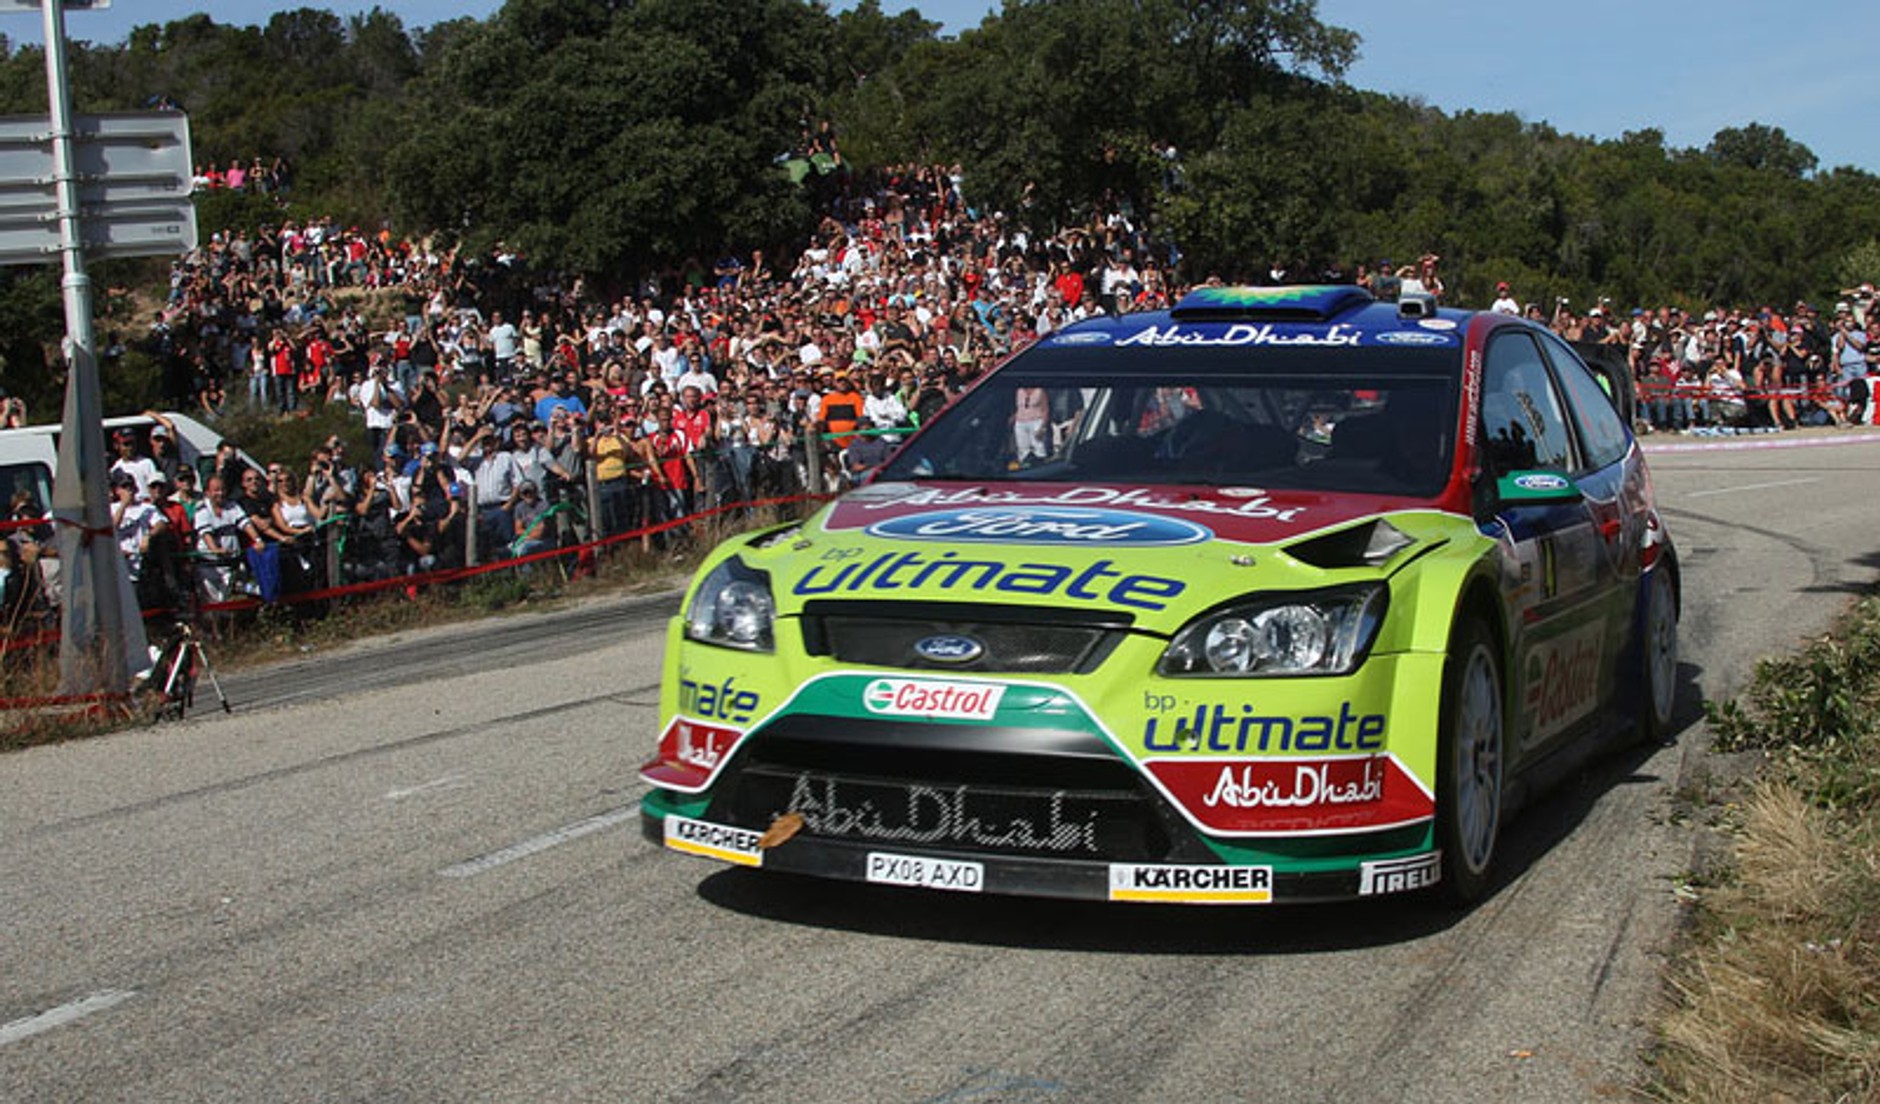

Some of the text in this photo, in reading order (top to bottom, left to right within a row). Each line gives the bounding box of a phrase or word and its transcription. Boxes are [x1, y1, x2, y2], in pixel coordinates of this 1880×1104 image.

[1114, 324, 1363, 347] Abu Dhabi
[863, 486, 1040, 509] Abu
[1045, 487, 1307, 523] Dhabi
[916, 511, 1148, 541] Ford
[819, 547, 863, 562] bp
[791, 551, 1187, 612] ultimate
[896, 683, 993, 714] Castrol
[1144, 691, 1177, 713] bp
[1143, 701, 1385, 752] ultimate
[1203, 762, 1383, 807] Abu Dhabi
[772, 770, 1099, 852] Abu Dhabi
[871, 856, 980, 888] PX08 AXD
[1134, 867, 1269, 889] KÄRCHER
